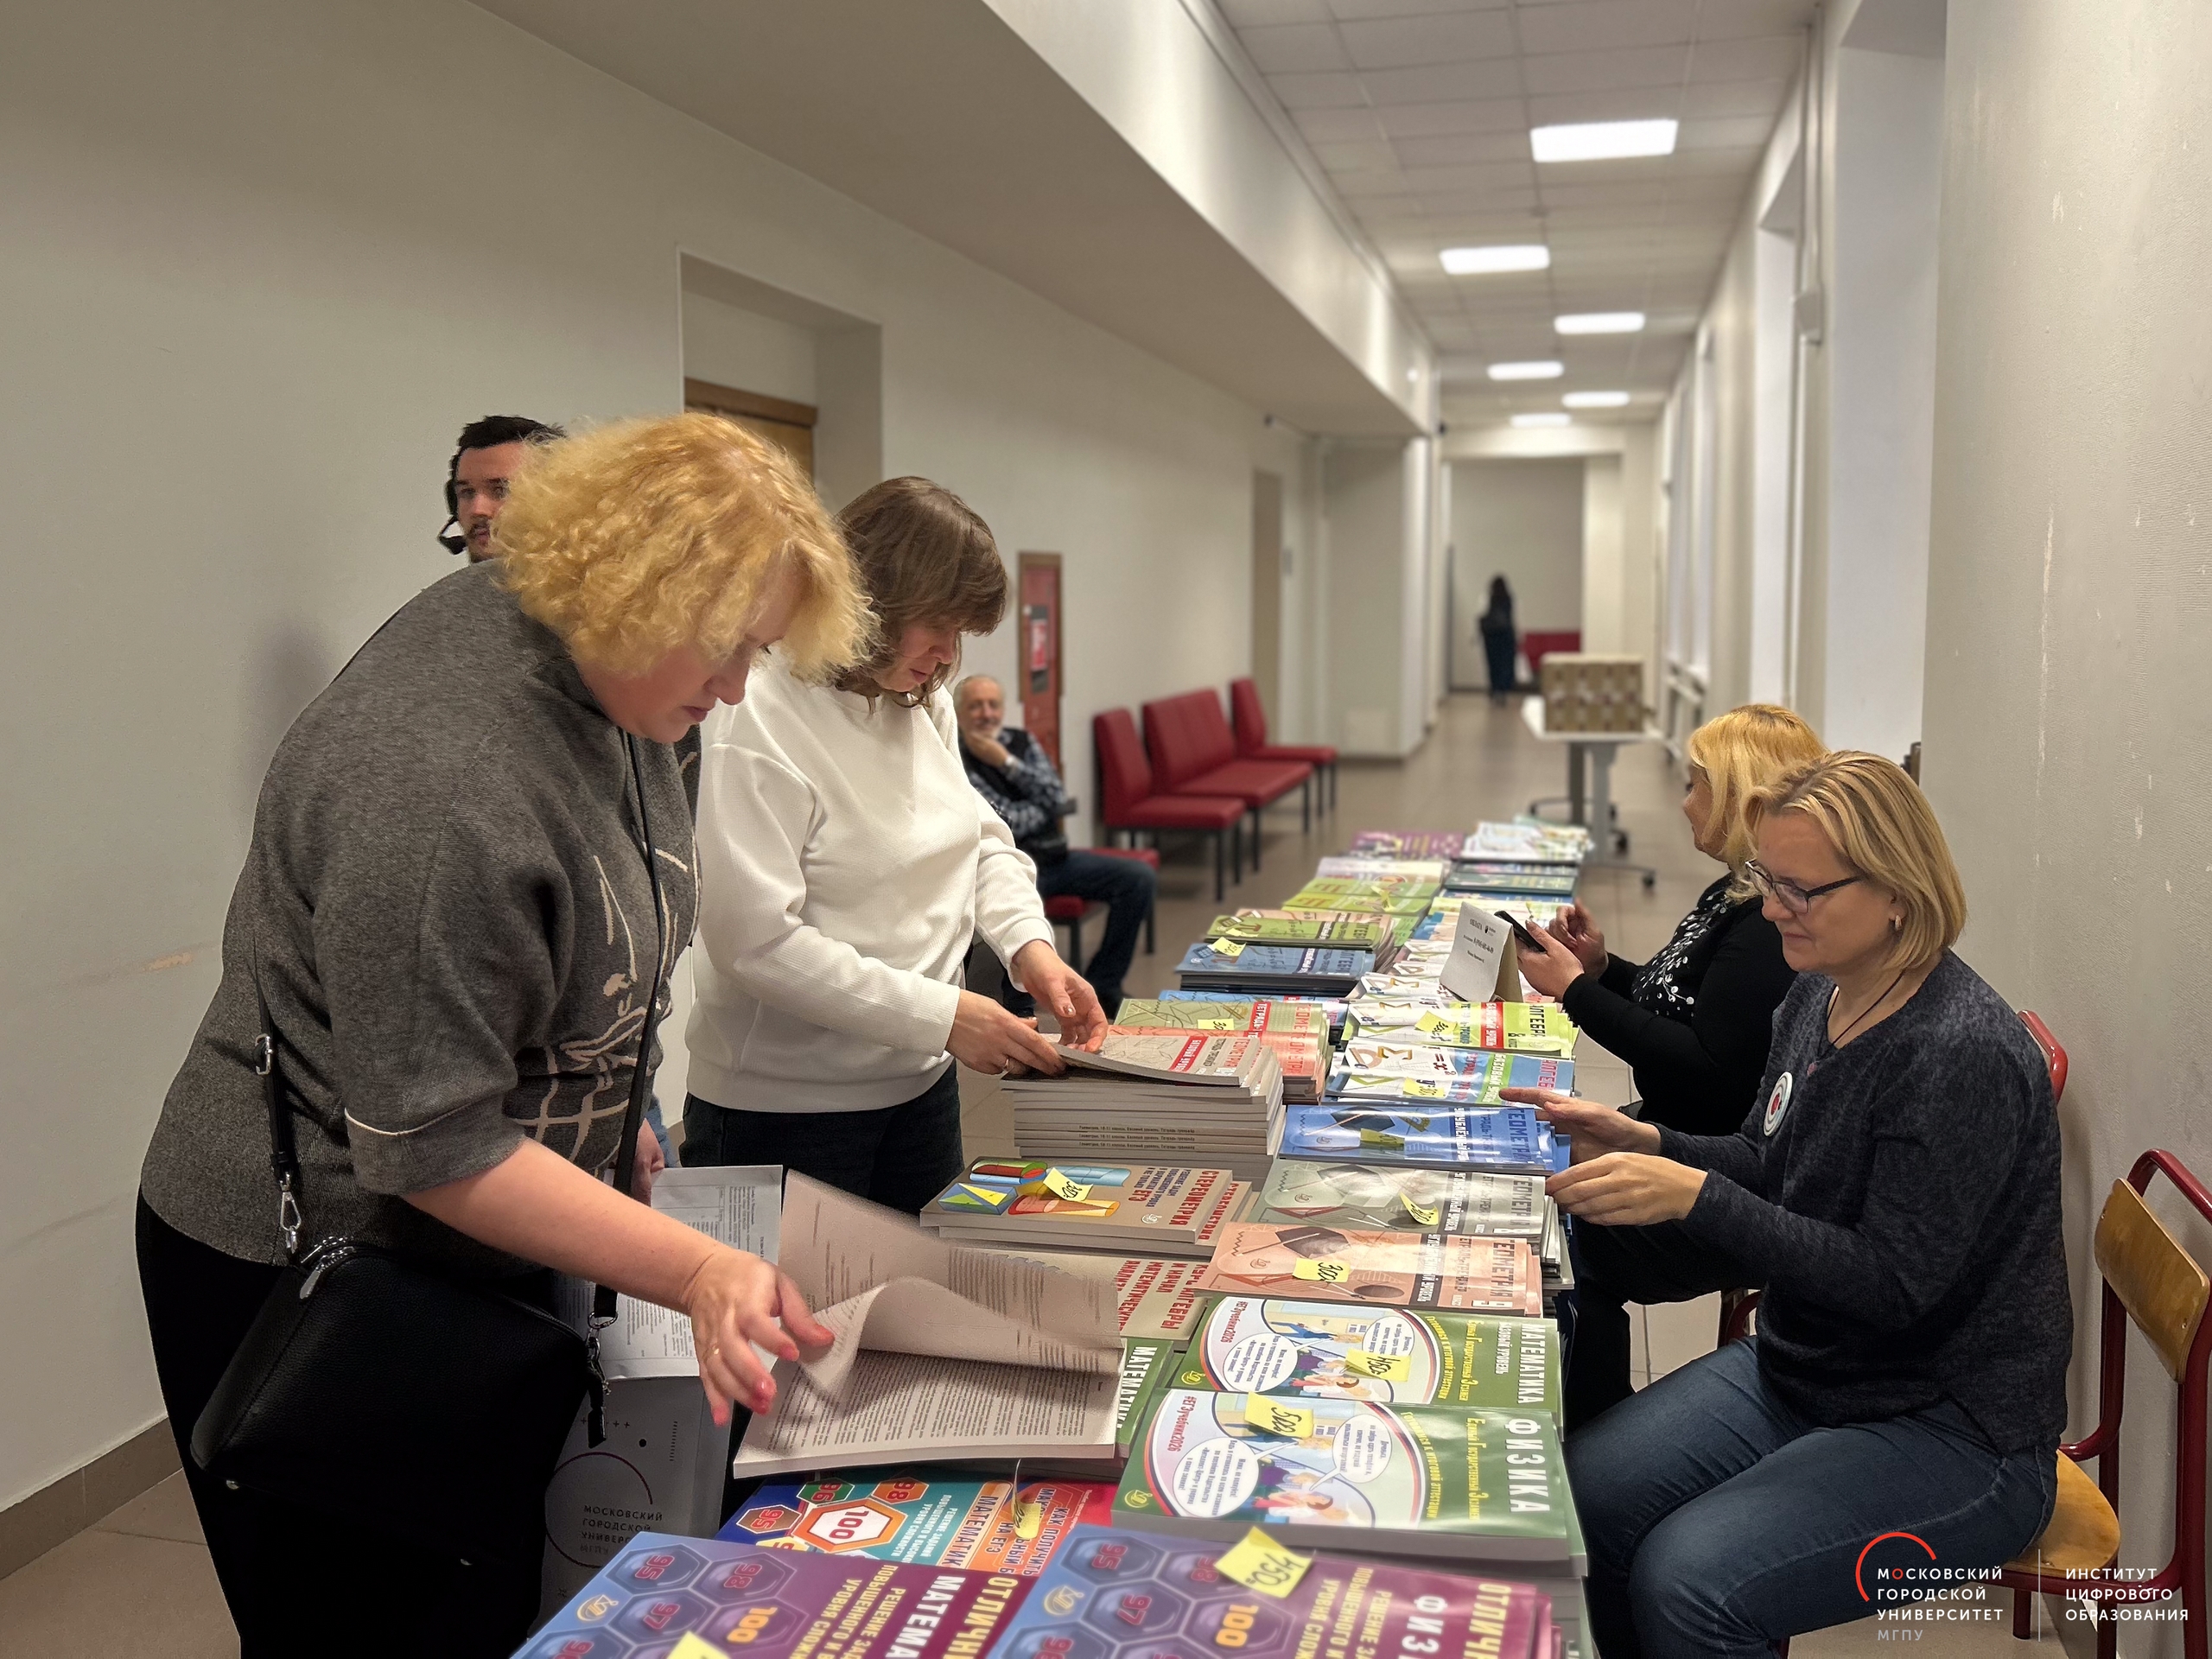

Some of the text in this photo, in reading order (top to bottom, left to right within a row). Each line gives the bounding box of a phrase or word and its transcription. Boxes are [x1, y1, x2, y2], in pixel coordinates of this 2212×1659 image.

[1489, 1053, 1507, 1084] БАЗОВЫЙ
[1536, 1059, 1559, 1088] АЛГЕБ
[1128, 1189, 1153, 1202] ЕГЭ
[1168, 1171, 1220, 1226] СТЕРЕОМЕТРИЯ
[1155, 1269, 1185, 1294] НАЧАЛ
[1160, 1287, 1194, 1329] АЛГЕБРЫ
[1220, 1300, 1249, 1343] #ЕГЭучебник2026
[1495, 1348, 1510, 1374] УРОВЕНЬ
[1517, 1324, 1547, 1404] МАТЕМАТИКА
[1117, 1346, 1158, 1429] МАТЕМАТИ
[1167, 1395, 1197, 1452] #ЕГЭучебник2026
[1504, 1419, 1550, 1513] ФИЗИКА
[811, 1484, 842, 1502] 96
[887, 1482, 916, 1501] 98
[582, 1518, 651, 1533] ГОРОДСКОЙ
[583, 1504, 663, 1522] МОСКОВСКИЙ
[751, 1509, 784, 1529] 95
[829, 1510, 870, 1539] 100
[581, 1531, 631, 1545] УНИВЕРС
[942, 1495, 1000, 1567] МАТЕМАТИК
[986, 1522, 1015, 1554] НА ЕГЭ
[1023, 1507, 1070, 1576] КАК ПОЛУЧИТЬ
[634, 1554, 675, 1580] 95
[1091, 1543, 1128, 1570] 95
[723, 1563, 763, 1588] 98
[819, 1579, 862, 1619] УРОВНЯ
[830, 1565, 899, 1639] ПОВЫШЕННОГО
[860, 1588, 906, 1637] РЕШЕНИЕ
[1116, 1593, 1152, 1624] 97
[1308, 1579, 1341, 1622] УРОВНЯ
[1330, 1567, 1374, 1646] ПОВЫШЕННОГО
[643, 1602, 681, 1630] 97
[725, 1606, 779, 1643] 100
[1215, 1605, 1259, 1647] 100
[1359, 1590, 1393, 1644] РЕШЕНИЕ
